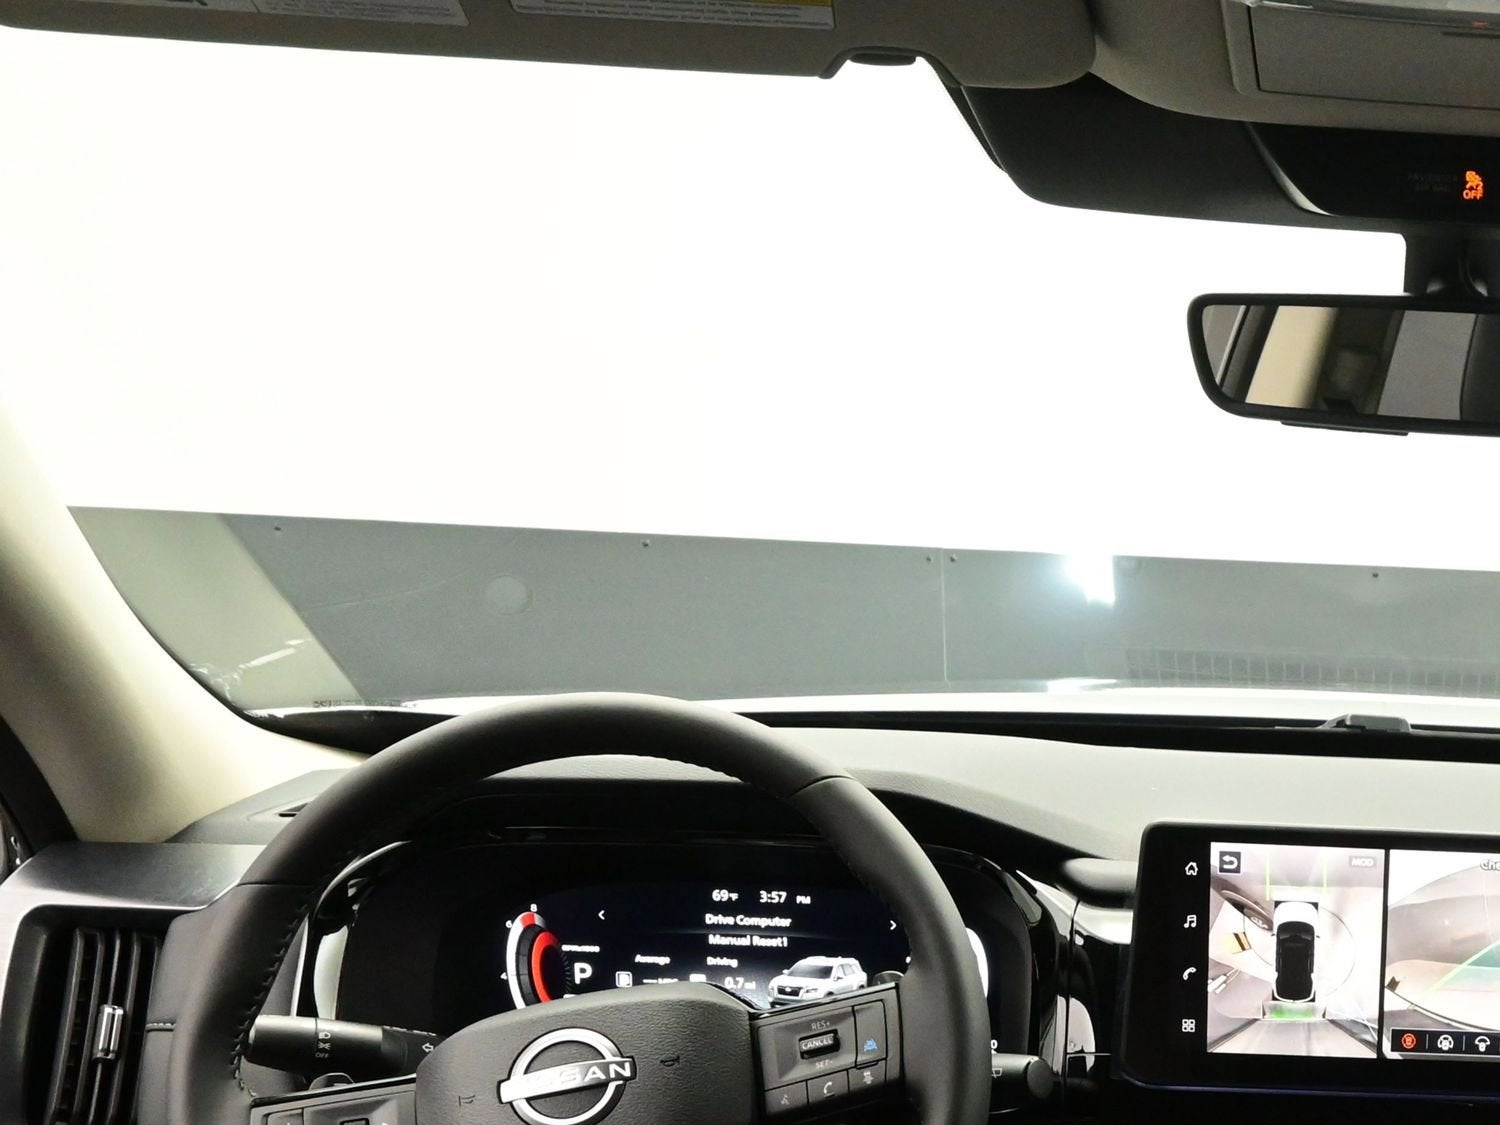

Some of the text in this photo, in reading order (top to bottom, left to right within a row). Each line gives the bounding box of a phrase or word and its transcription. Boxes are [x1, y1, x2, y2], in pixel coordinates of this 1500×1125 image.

[1463, 189, 1484, 201] OFF
[760, 890, 787, 904] 3:57
[796, 895, 811, 905] PM
[530, 903, 538, 913] 8
[705, 913, 792, 928] Drive Computer
[708, 934, 751, 946] Manual
[635, 954, 670, 966] Average
[707, 957, 738, 969] Driving
[574, 962, 593, 985] P
[802, 1035, 834, 1050] CANCEL
